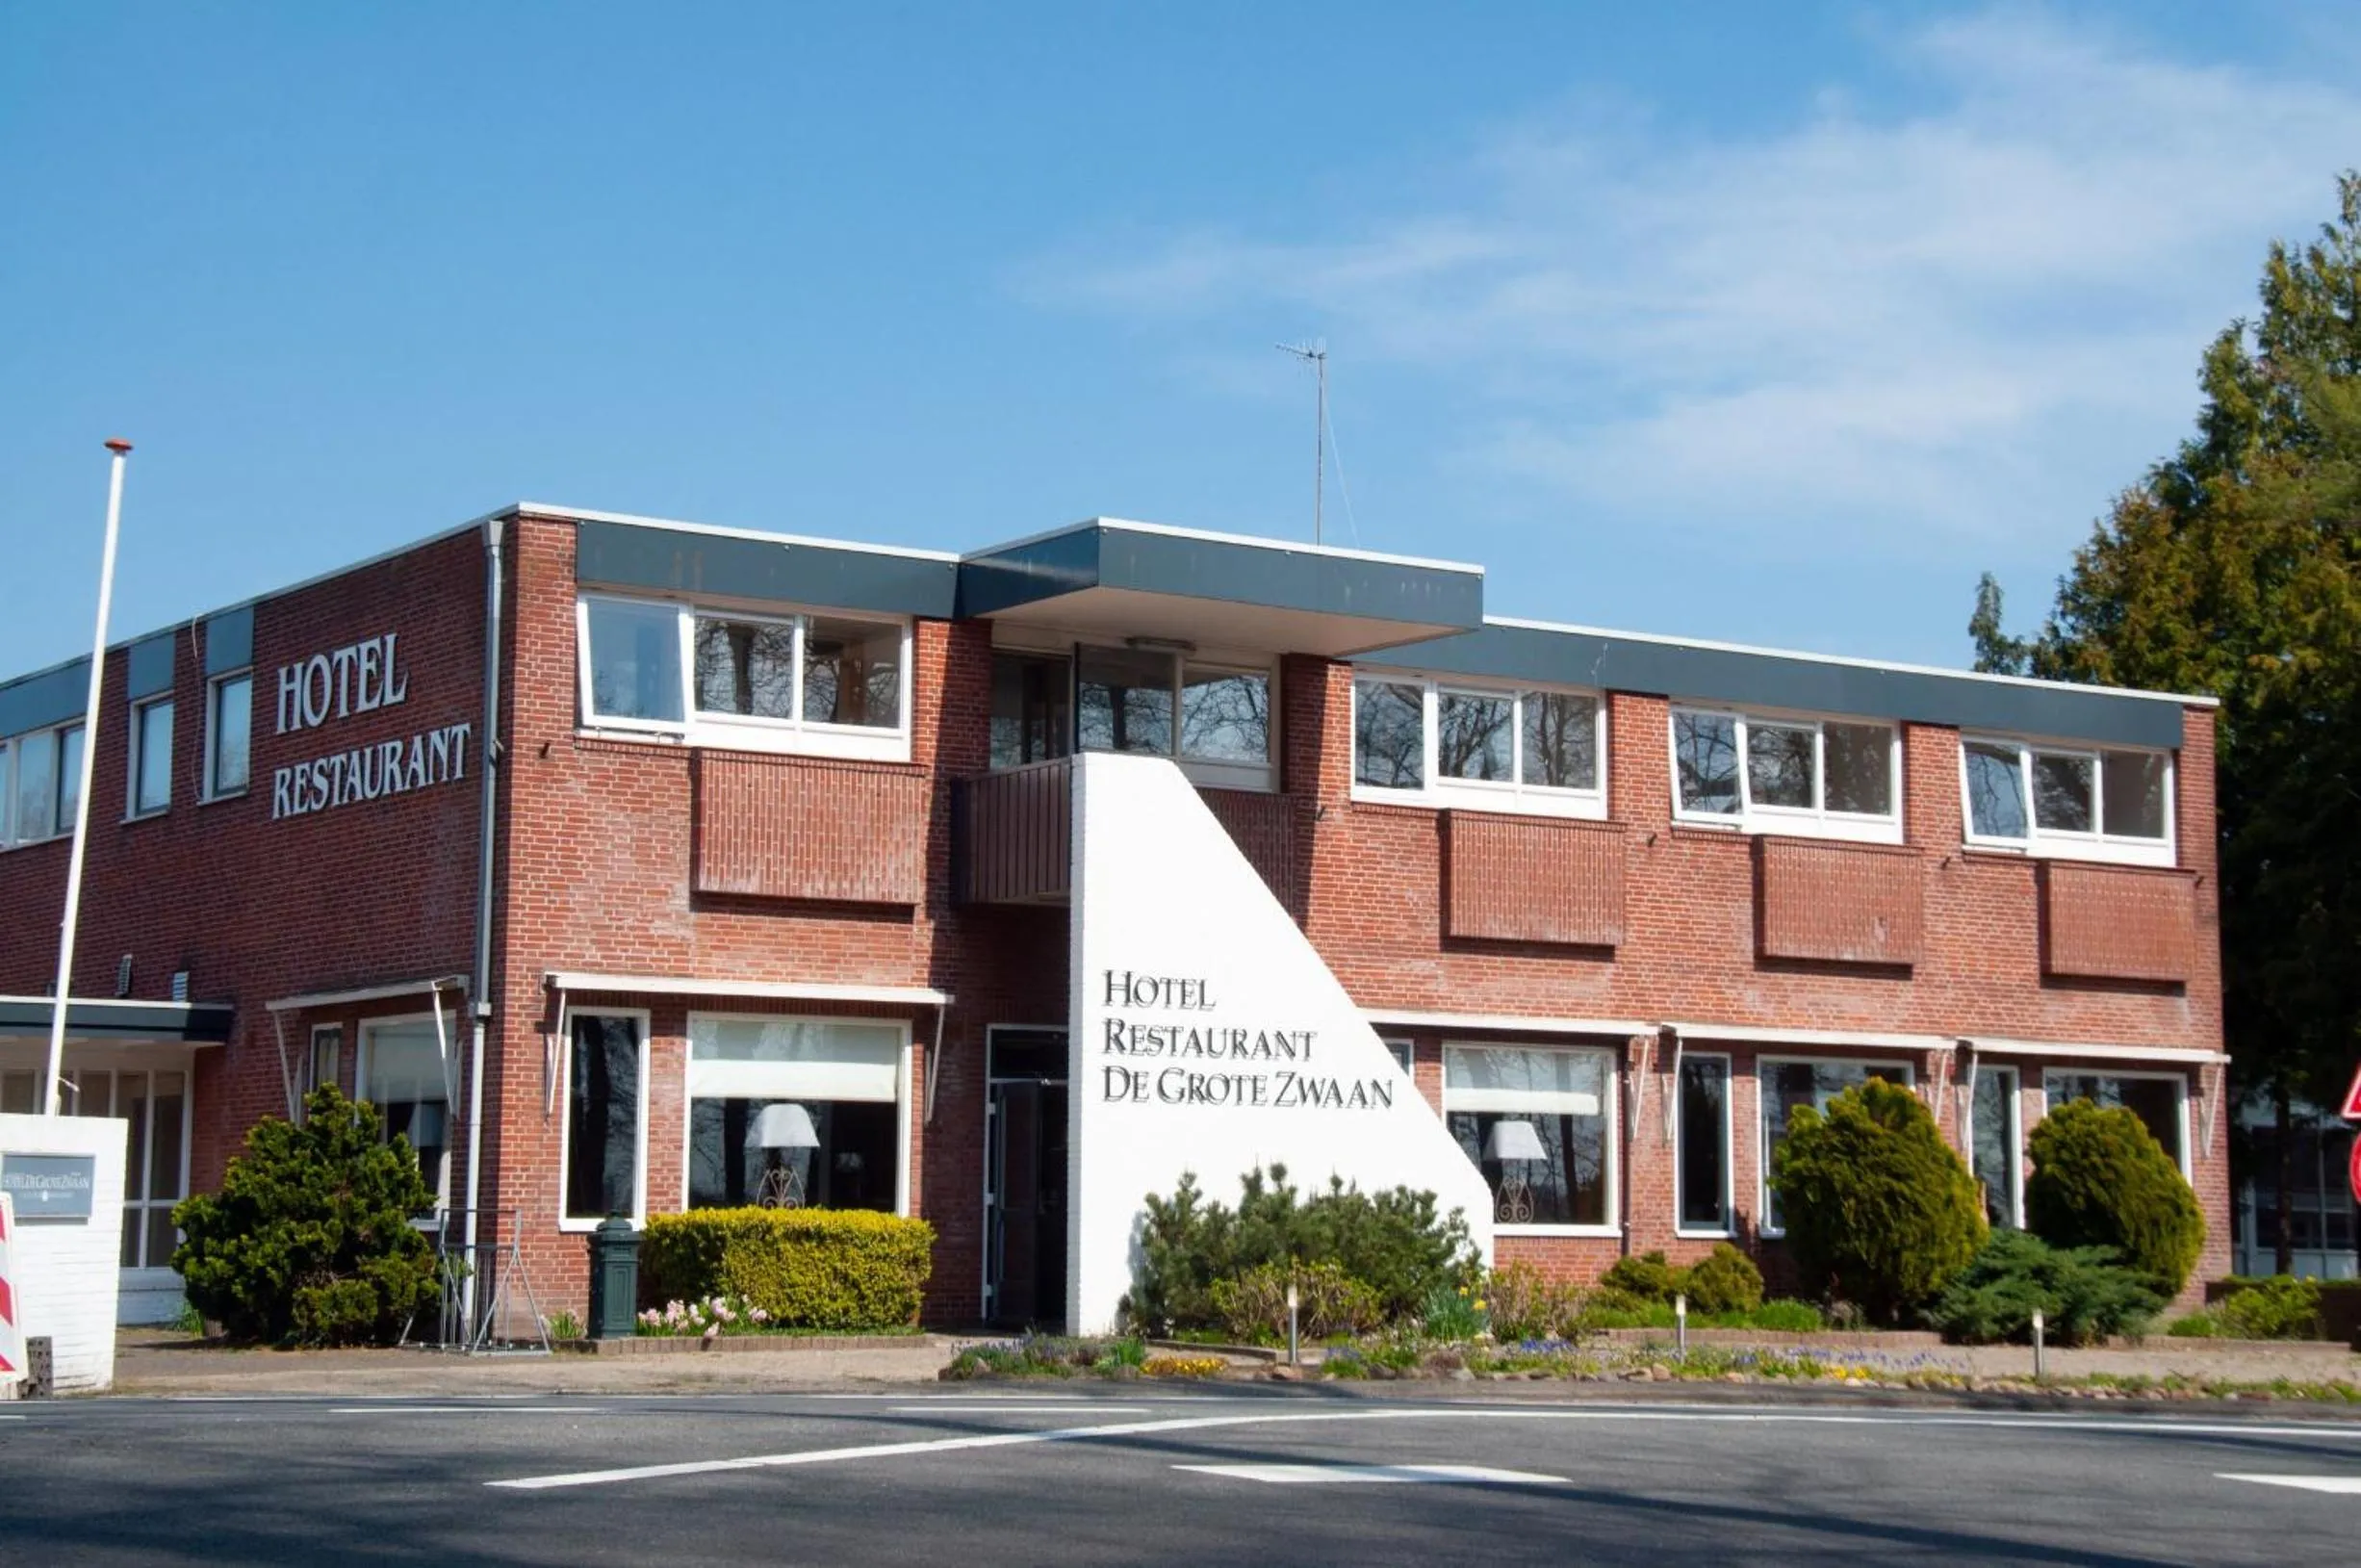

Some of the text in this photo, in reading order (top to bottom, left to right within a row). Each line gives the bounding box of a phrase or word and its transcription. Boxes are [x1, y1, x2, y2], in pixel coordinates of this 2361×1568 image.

[276, 632, 408, 734] HOTEL
[272, 723, 471, 820] RESTAURANT
[1102, 969, 1217, 1011] HOTEL
[1102, 1017, 1318, 1062] RESTAURANT
[1102, 1065, 1393, 1109] DE GROTE ZWAAN
